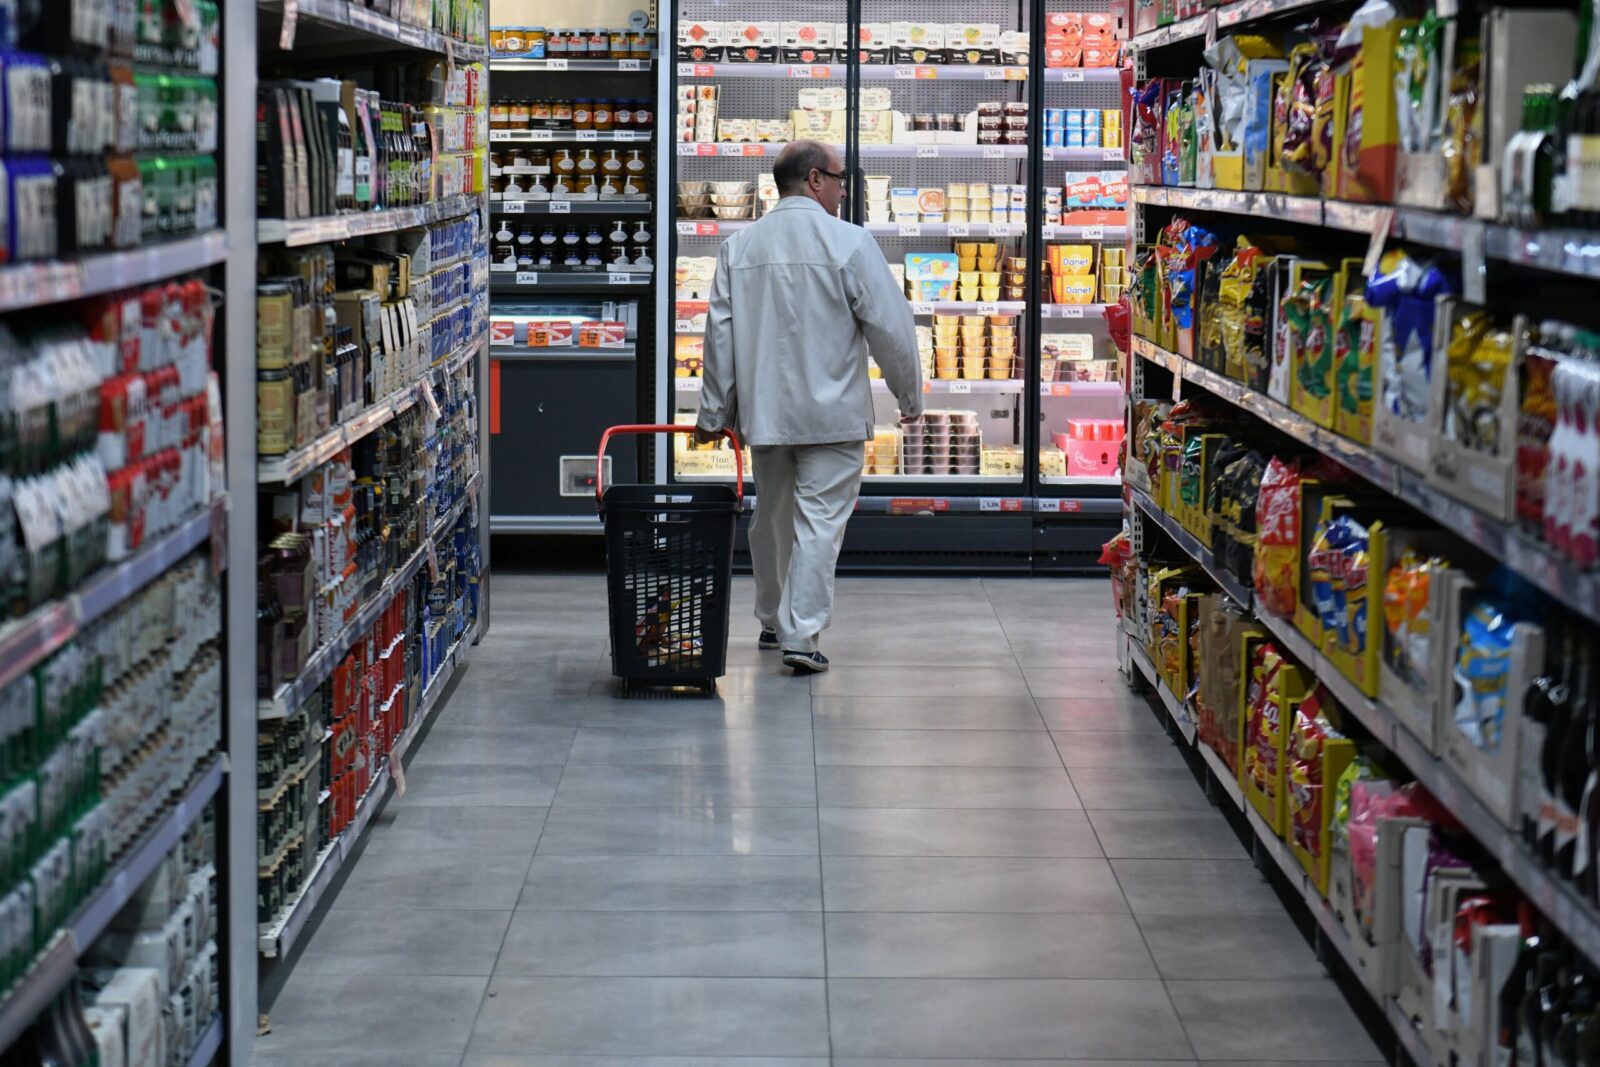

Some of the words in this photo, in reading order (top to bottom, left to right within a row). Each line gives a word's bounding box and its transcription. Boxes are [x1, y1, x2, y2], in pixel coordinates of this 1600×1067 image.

[1070, 183, 1100, 195] Royal
[1063, 258, 1089, 266] Danet
[1066, 286, 1091, 295] Danet
